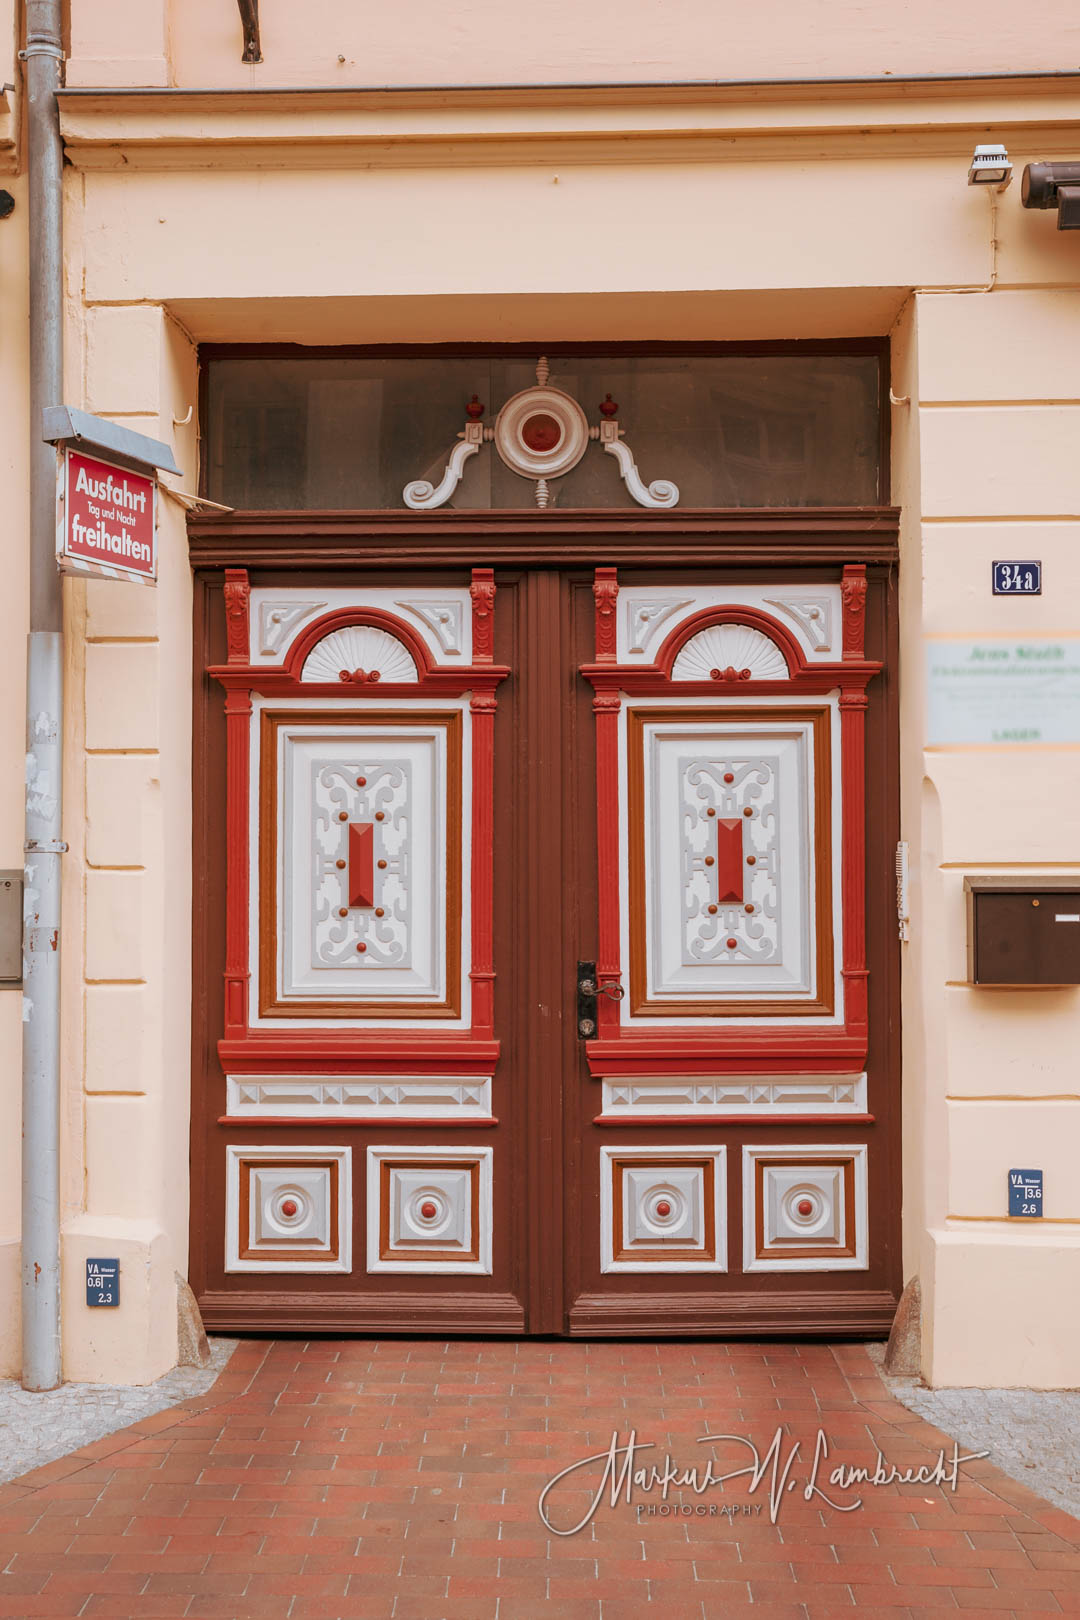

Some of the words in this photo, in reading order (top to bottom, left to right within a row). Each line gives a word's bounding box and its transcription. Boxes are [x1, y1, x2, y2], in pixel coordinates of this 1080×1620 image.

[75, 467, 146, 513] Ausfahrt
[88, 501, 99, 519] Tag
[101, 508, 115, 520] und
[116, 510, 136, 526] Nacht
[72, 514, 151, 562] freihalten
[1001, 565, 1033, 590] 34a
[1011, 1174, 1023, 1185] VA
[87, 1263, 99, 1274] VA
